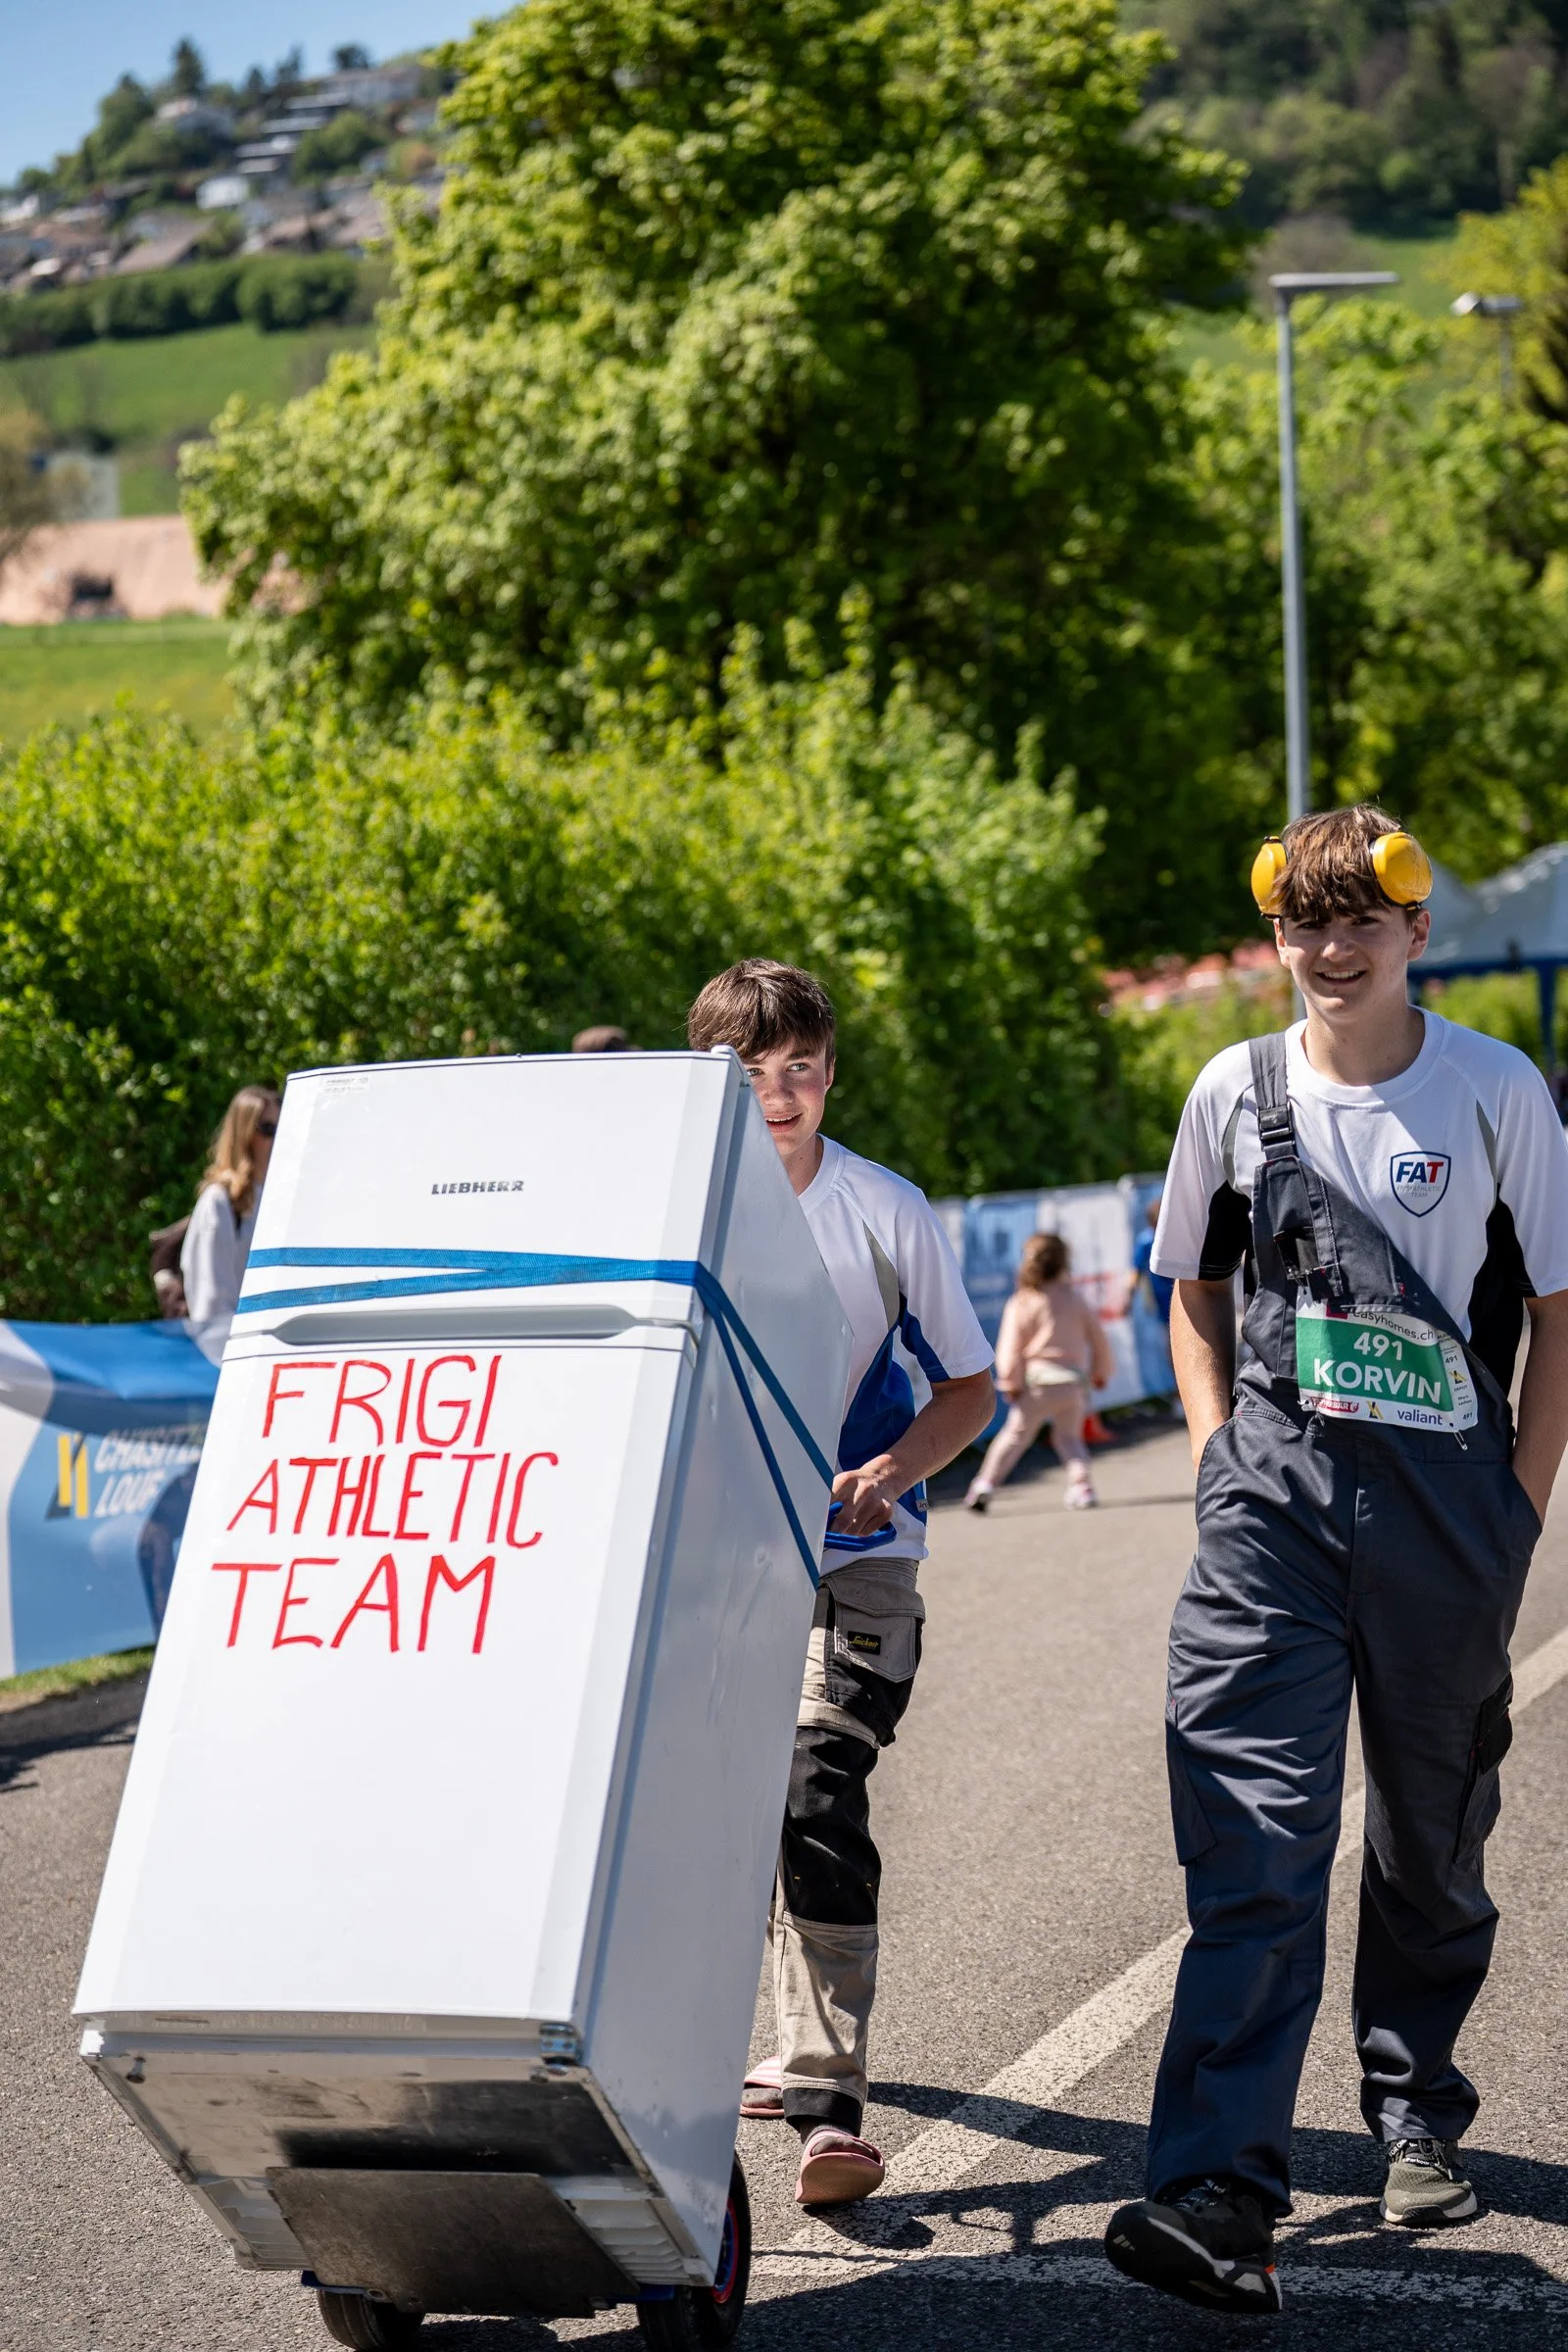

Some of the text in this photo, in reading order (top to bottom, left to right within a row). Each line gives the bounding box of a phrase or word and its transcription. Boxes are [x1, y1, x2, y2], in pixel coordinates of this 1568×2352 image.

[1396, 1161, 1444, 1183] FAT
[431, 1180, 524, 1196] LIEBHERR
[1352, 1312, 1434, 1341] easyhomes.ch
[1353, 1331, 1402, 1361] 491
[1445, 1354, 1458, 1364] 491
[1314, 1358, 1441, 1404] KORVIN
[263, 1354, 502, 1447] FRIGI
[1397, 1409, 1443, 1425] valiant
[1462, 1411, 1473, 1420] 491
[227, 1450, 559, 1549] ATHLETIC
[212, 1553, 496, 1654] TEAM
